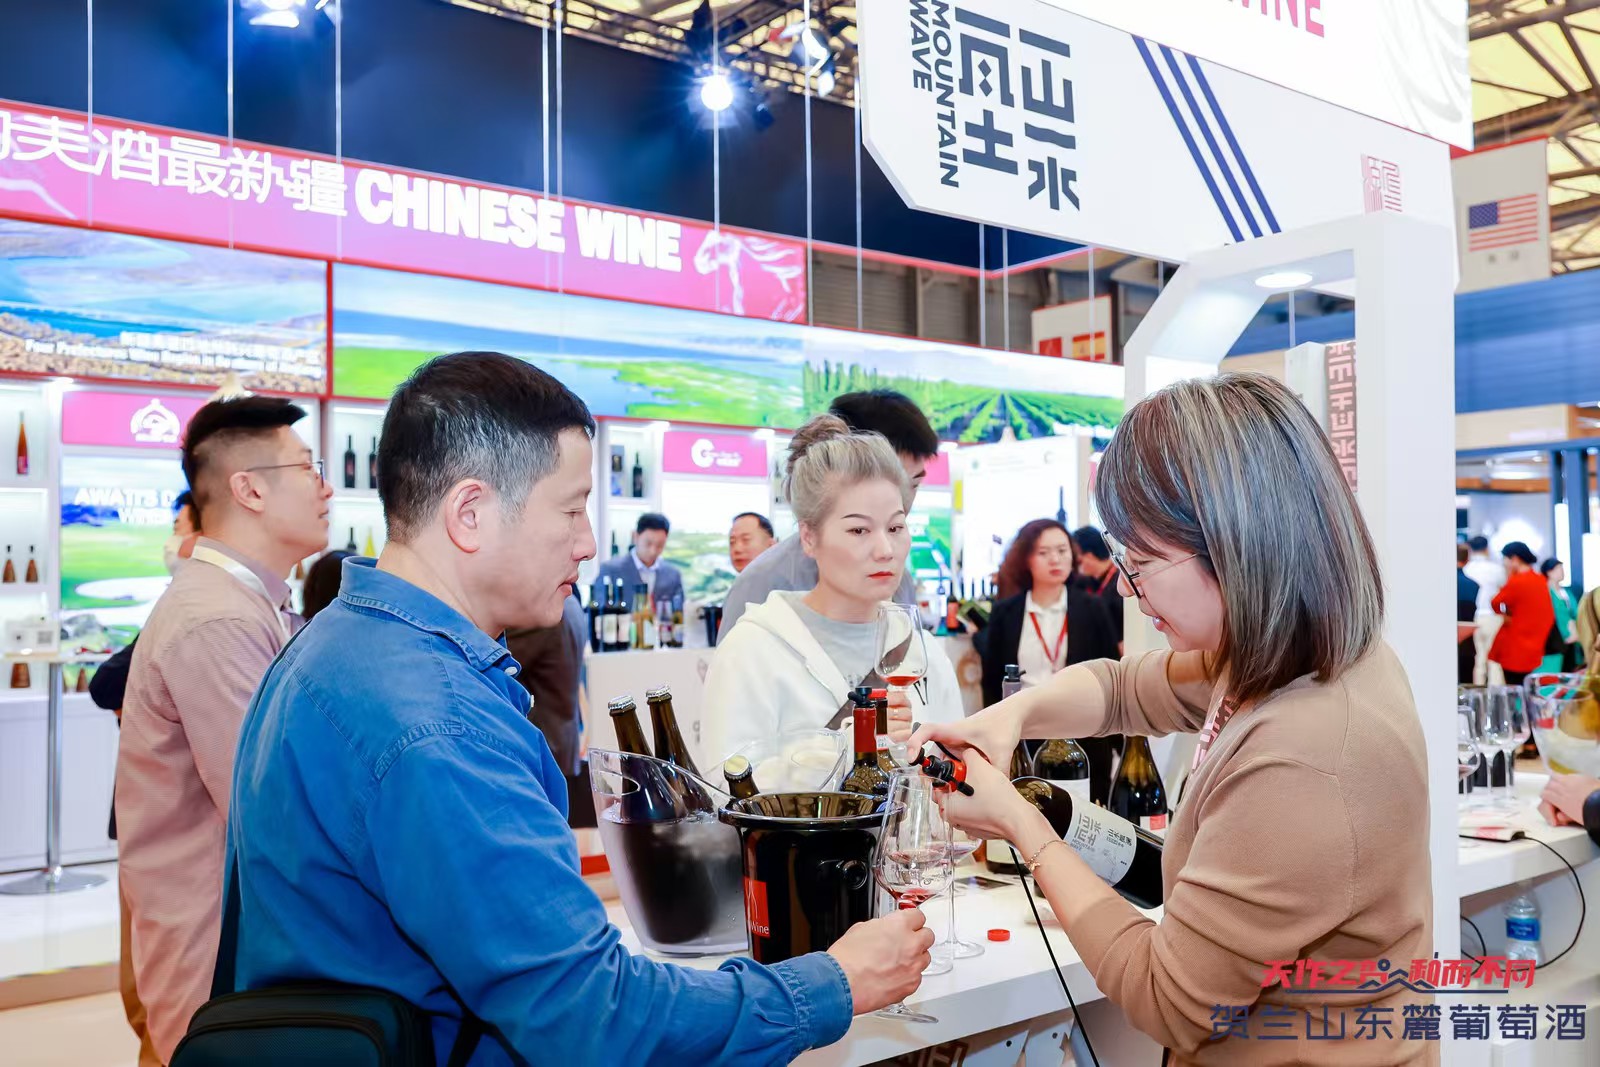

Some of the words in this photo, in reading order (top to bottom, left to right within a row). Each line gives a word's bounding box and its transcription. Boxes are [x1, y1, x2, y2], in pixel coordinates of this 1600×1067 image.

[909, 0, 932, 92] WAVE
[931, 0, 959, 188] MOUNTAIN
[0, 111, 348, 216] 美酒最新疆
[354, 168, 566, 253] CHINESE
[574, 205, 682, 272] WINE
